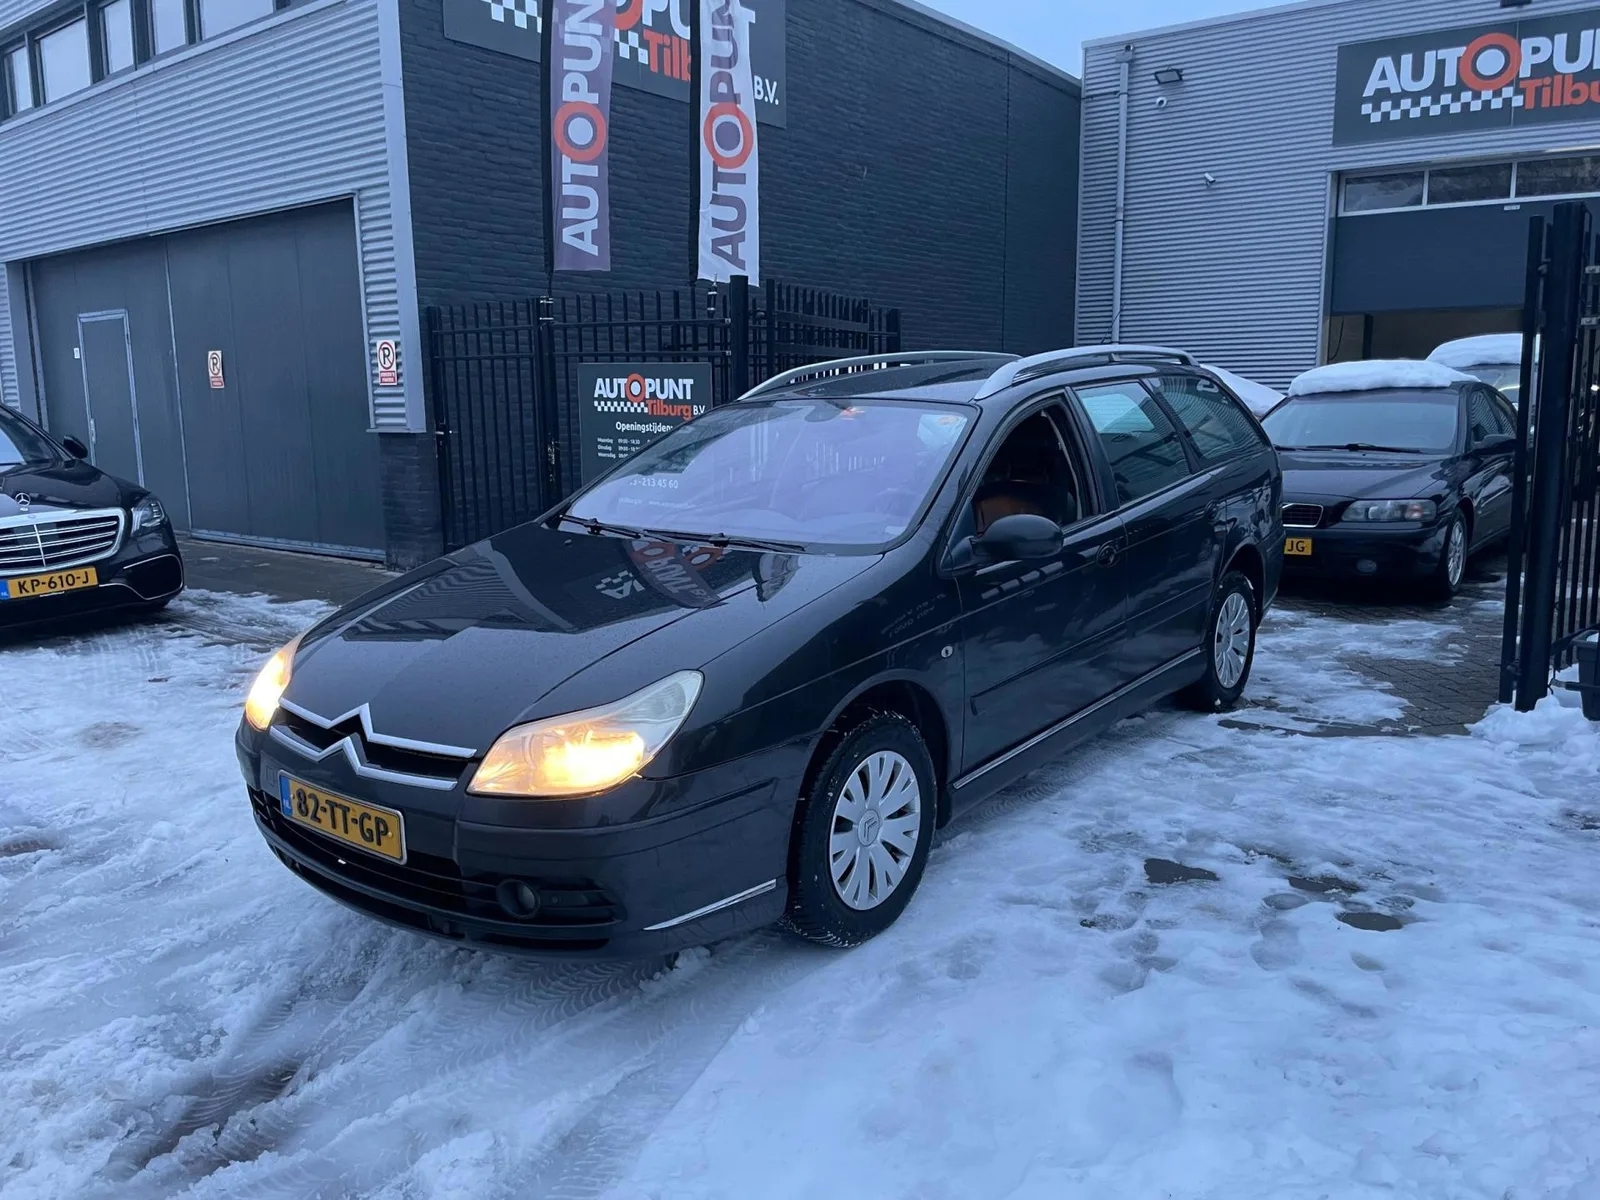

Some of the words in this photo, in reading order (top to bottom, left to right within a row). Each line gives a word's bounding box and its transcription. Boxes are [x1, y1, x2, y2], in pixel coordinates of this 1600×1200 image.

[1362, 28, 1600, 97] AUTOPU
[754, 74, 779, 105] B.V.
[594, 373, 694, 403] AUTOPUNT
[646, 400, 692, 421] Tilburg
[18, 571, 90, 594] KP-610-J
[295, 788, 390, 847] 82-TT-GP
